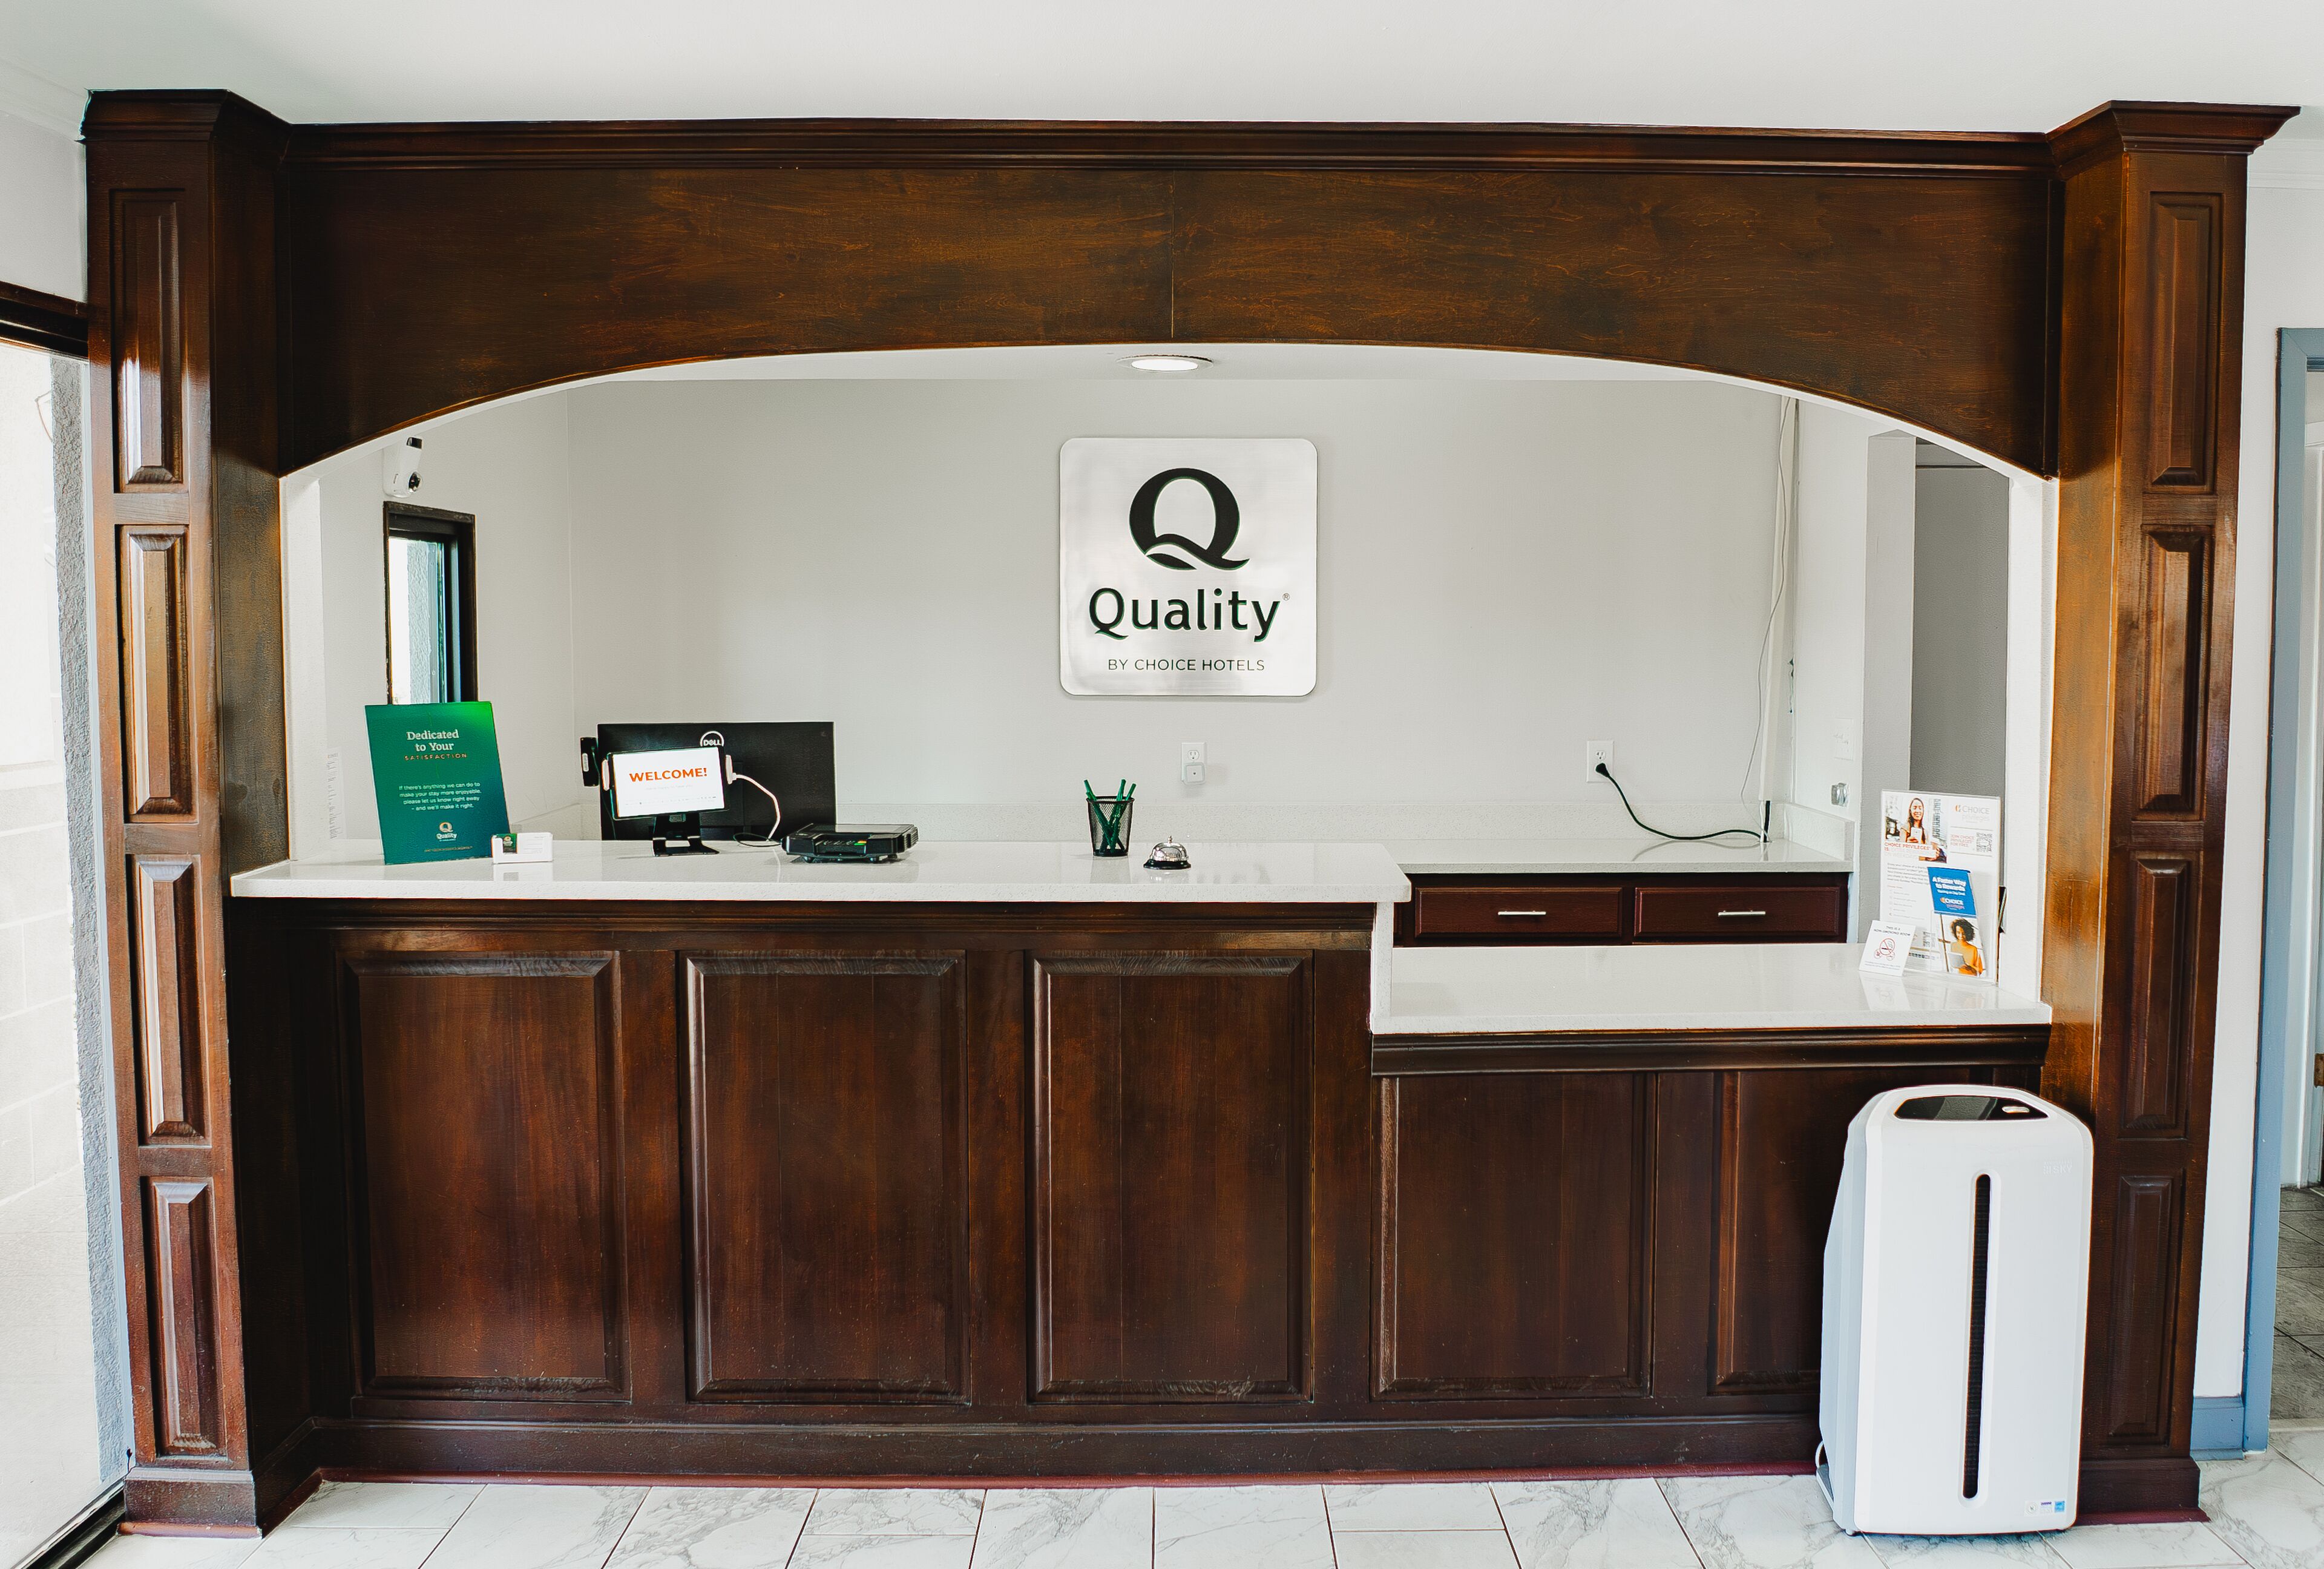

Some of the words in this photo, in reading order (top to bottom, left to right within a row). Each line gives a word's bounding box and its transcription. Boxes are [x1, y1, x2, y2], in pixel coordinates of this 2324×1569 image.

[1129, 467, 1251, 571] Q
[1089, 588, 1281, 642] Quality
[1108, 659, 1129, 671] BY
[1135, 659, 1196, 671] CHOICE
[1202, 659, 1265, 671] HOTELS
[406, 729, 459, 740] Dedicated
[415, 743, 427, 752] to
[428, 742, 455, 751] Your
[629, 768, 707, 783] WELCOME!
[1962, 806, 1991, 814] CHOICE
